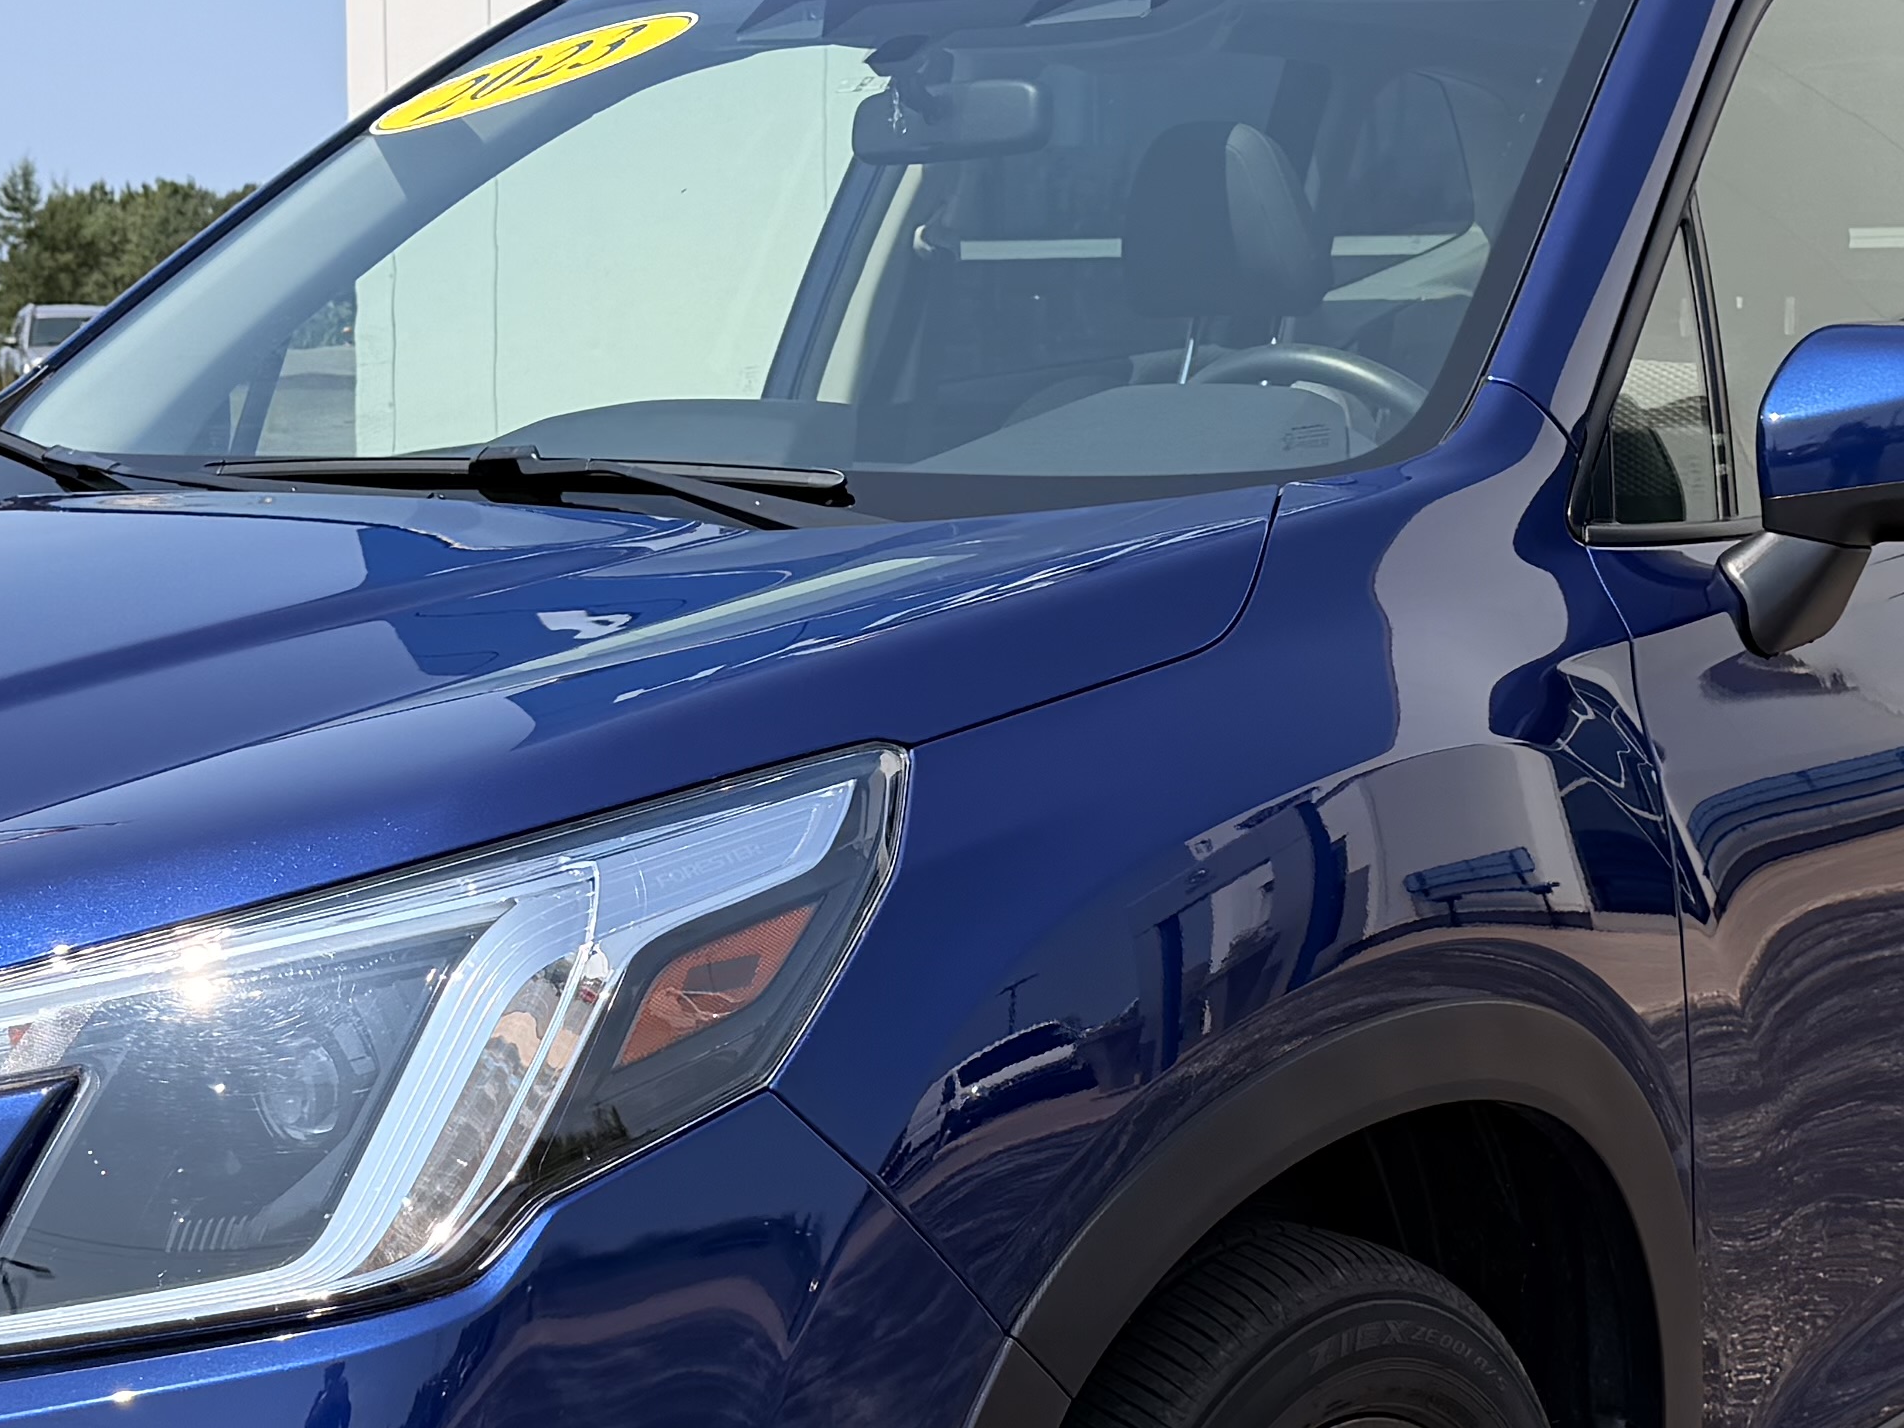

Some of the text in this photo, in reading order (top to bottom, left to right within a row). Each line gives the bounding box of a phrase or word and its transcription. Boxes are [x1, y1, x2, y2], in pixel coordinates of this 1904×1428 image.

[409, 23, 649, 123] 2023
[655, 843, 764, 890] FORESTER
[1307, 1318, 1412, 1376] ZIEX
